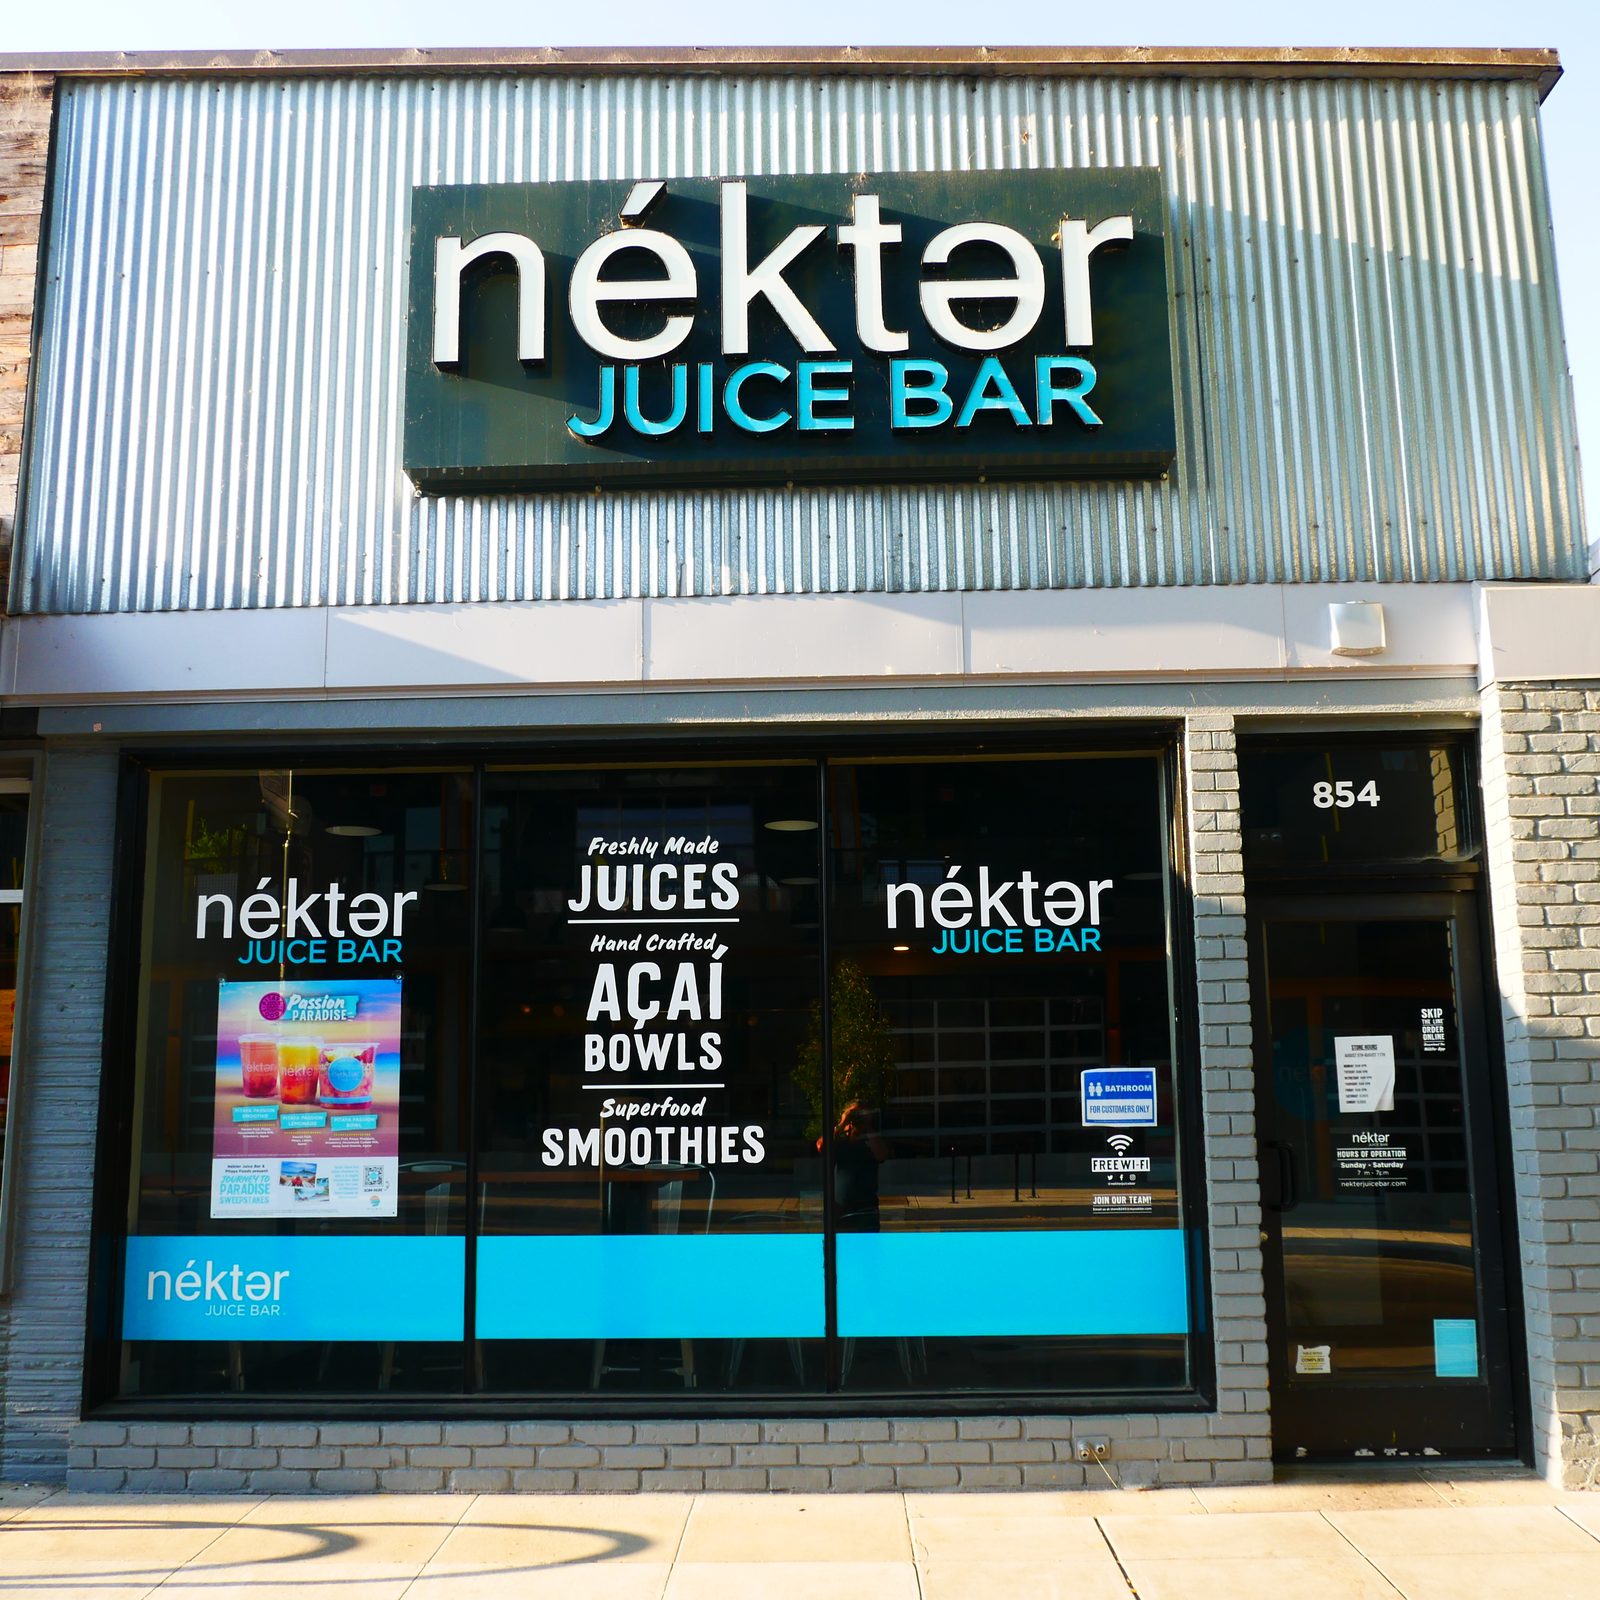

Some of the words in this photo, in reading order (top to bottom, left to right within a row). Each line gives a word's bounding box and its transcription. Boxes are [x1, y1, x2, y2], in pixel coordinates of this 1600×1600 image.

[431, 180, 1134, 365] néktər
[566, 359, 855, 439] JUICE
[889, 355, 1104, 430] BAR
[1312, 780, 1381, 809] 854
[588, 837, 659, 858] Freshly
[663, 835, 720, 855] Made
[567, 862, 740, 912] JUICES
[886, 865, 1114, 929] néktər
[196, 876, 418, 939] néktər
[589, 933, 642, 953] Hand
[645, 932, 717, 952] Crafted
[932, 928, 1024, 954] JUICE
[1034, 927, 1102, 953] BAR
[237, 939, 327, 965] JUICE
[337, 938, 403, 964] BAR
[585, 943, 729, 1031] AÇAÍ
[287, 993, 345, 1011] Passion
[292, 1009, 347, 1021] PARADISE
[1421, 1008, 1443, 1019] SKIP
[1422, 1026, 1444, 1034] ORDER
[1423, 1033, 1445, 1041] ONLINE
[584, 1032, 723, 1072] BOWLS
[1104, 1085, 1152, 1093] BATHROOM
[599, 1096, 707, 1121] Superfood
[1089, 1105, 1101, 1113] FOR
[1101, 1105, 1135, 1113] CUSTOMERS
[1135, 1104, 1150, 1113] ONLY
[541, 1125, 766, 1168] SMOOTHIES
[1337, 1150, 1360, 1158] HOURS
[1093, 1159, 1119, 1171] FREE
[1120, 1159, 1149, 1170] WI-FI
[1340, 1162, 1367, 1170] Sunday
[1372, 1161, 1404, 1169] Saturday
[221, 1175, 259, 1183] JOURNEY
[219, 1183, 271, 1195] PARADISE
[219, 1195, 270, 1204] SWEEPSTAKES
[1092, 1196, 1110, 1205] JOIN
[1111, 1196, 1127, 1205] OUR
[1128, 1195, 1152, 1204] TEAM!
[147, 1259, 290, 1301] néktər
[204, 1304, 246, 1316] JUICE
[250, 1304, 280, 1316] BAR
